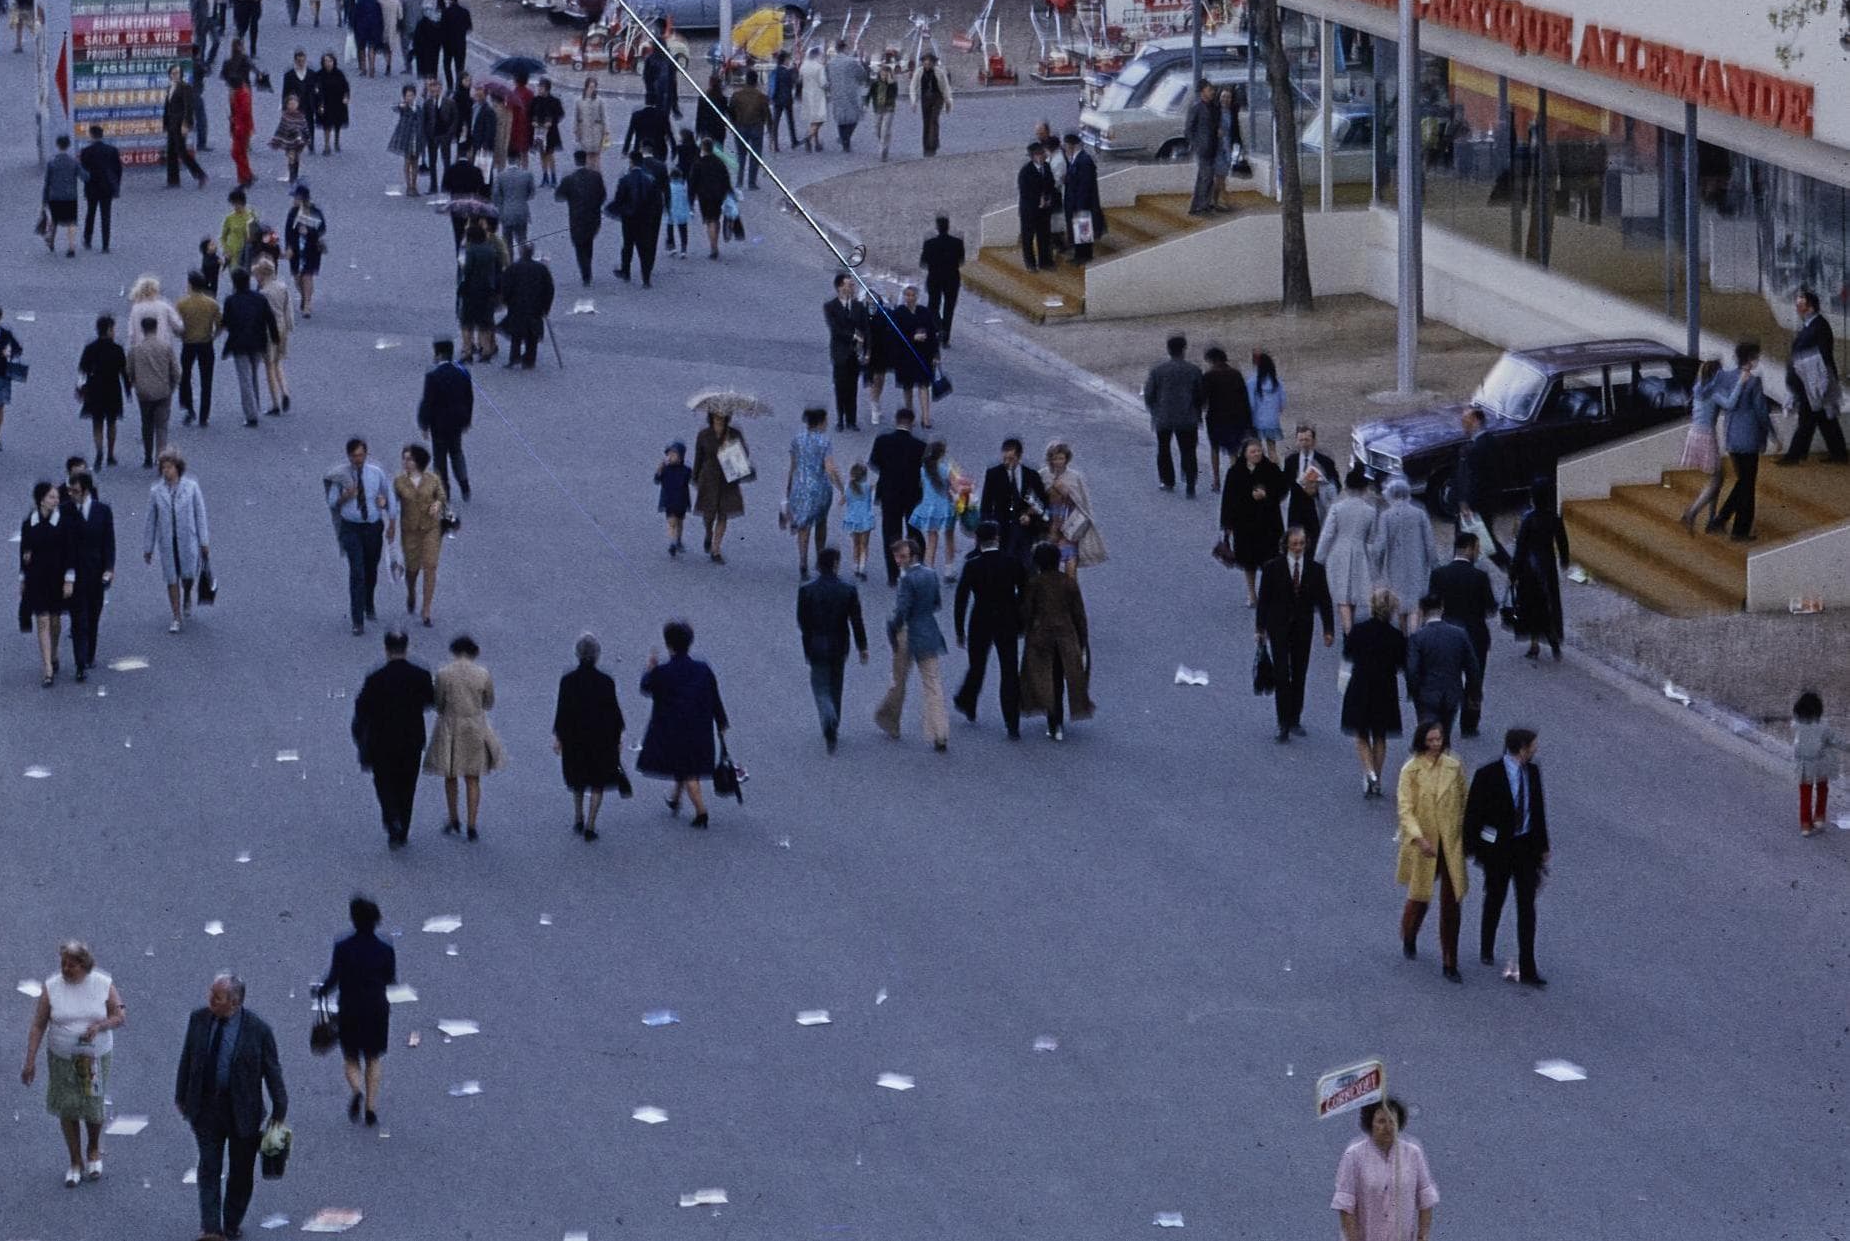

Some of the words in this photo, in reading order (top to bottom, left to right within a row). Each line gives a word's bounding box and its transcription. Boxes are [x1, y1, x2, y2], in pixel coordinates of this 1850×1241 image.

[83, 32, 120, 47] SALON
[126, 31, 148, 45] DES
[153, 30, 180, 43] VINS
